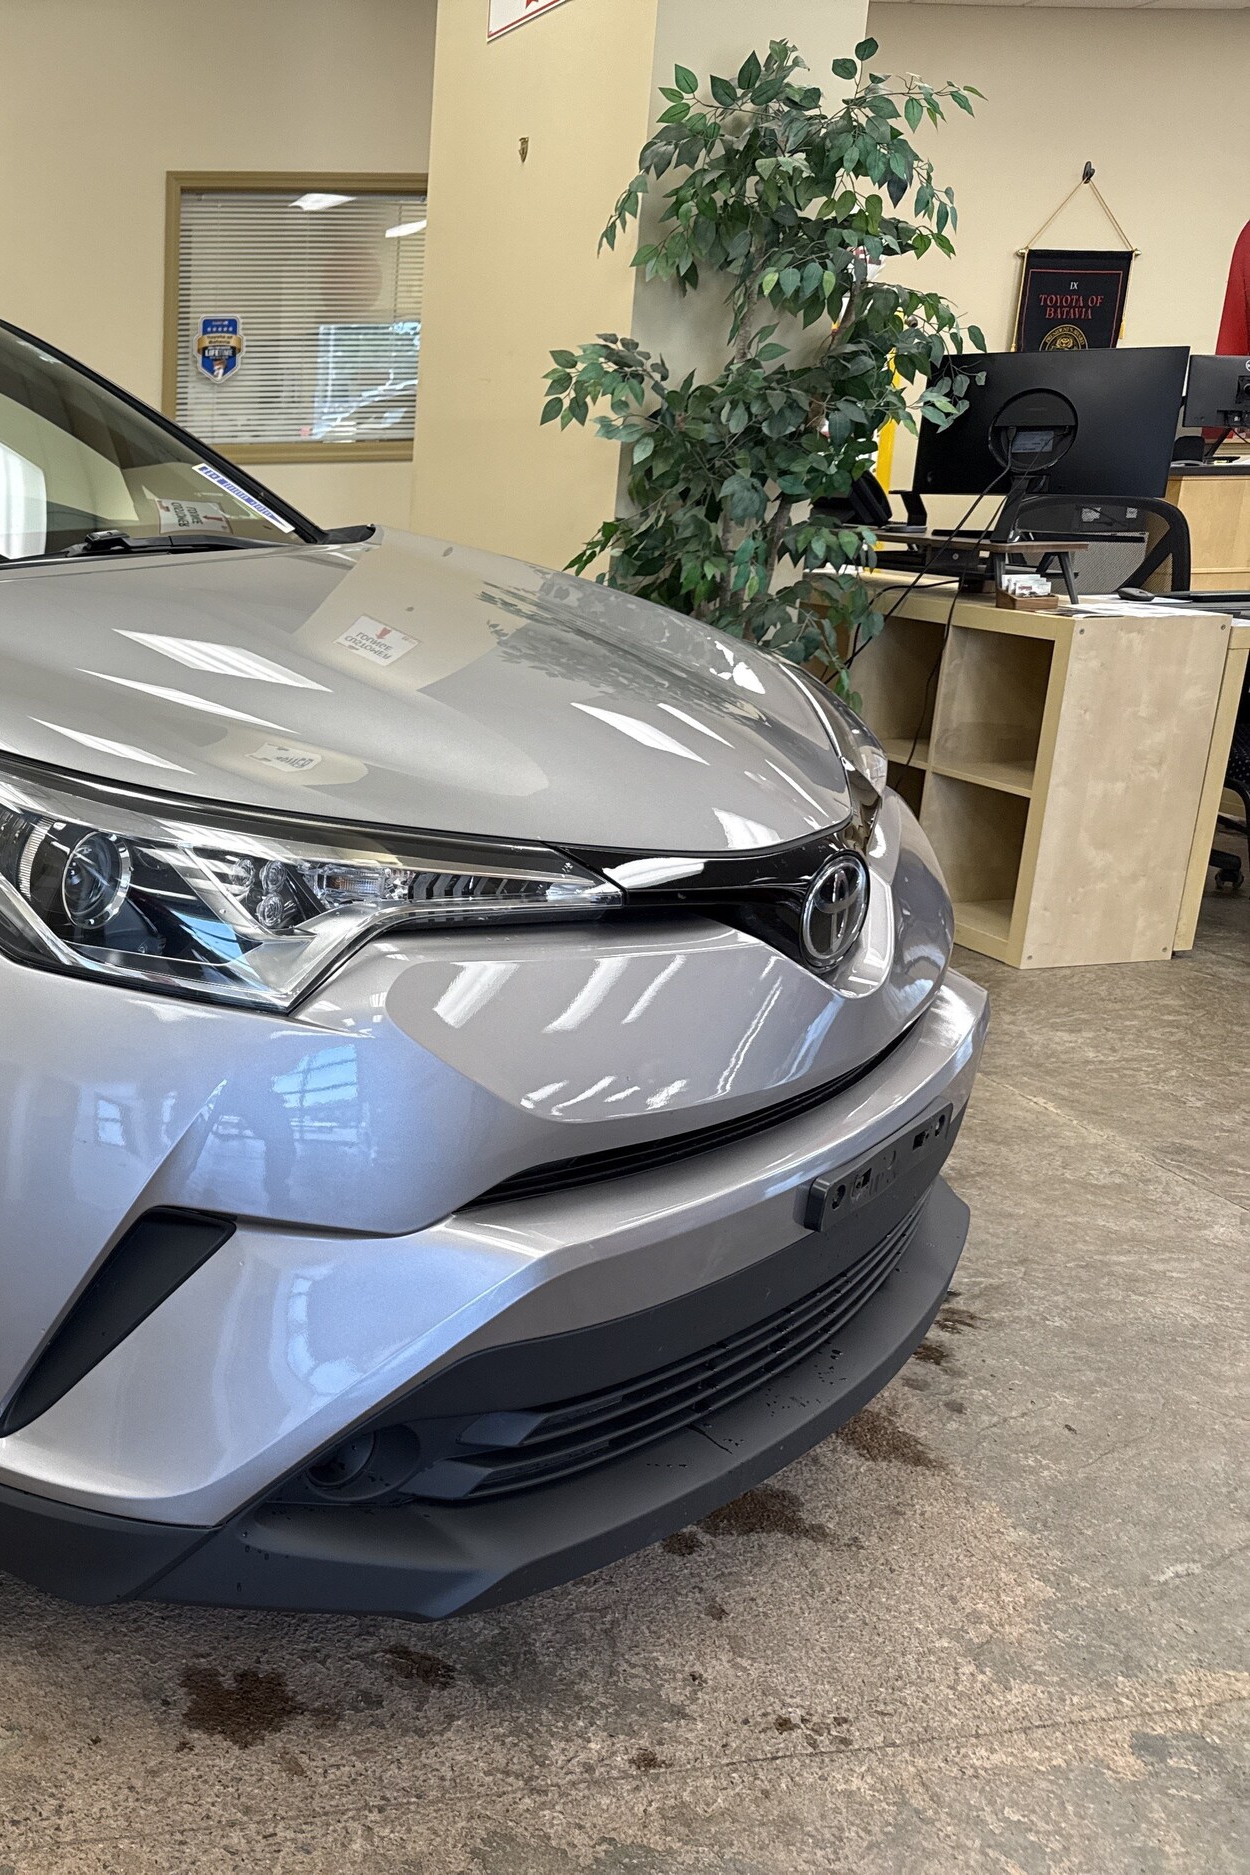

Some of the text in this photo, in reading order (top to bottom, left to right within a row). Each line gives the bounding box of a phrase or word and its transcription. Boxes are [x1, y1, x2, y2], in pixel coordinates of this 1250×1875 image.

[1069, 281, 1079, 290] IX
[1039, 294, 1105, 307] TOYOTA OF
[1045, 307, 1092, 319] BATAVIA
